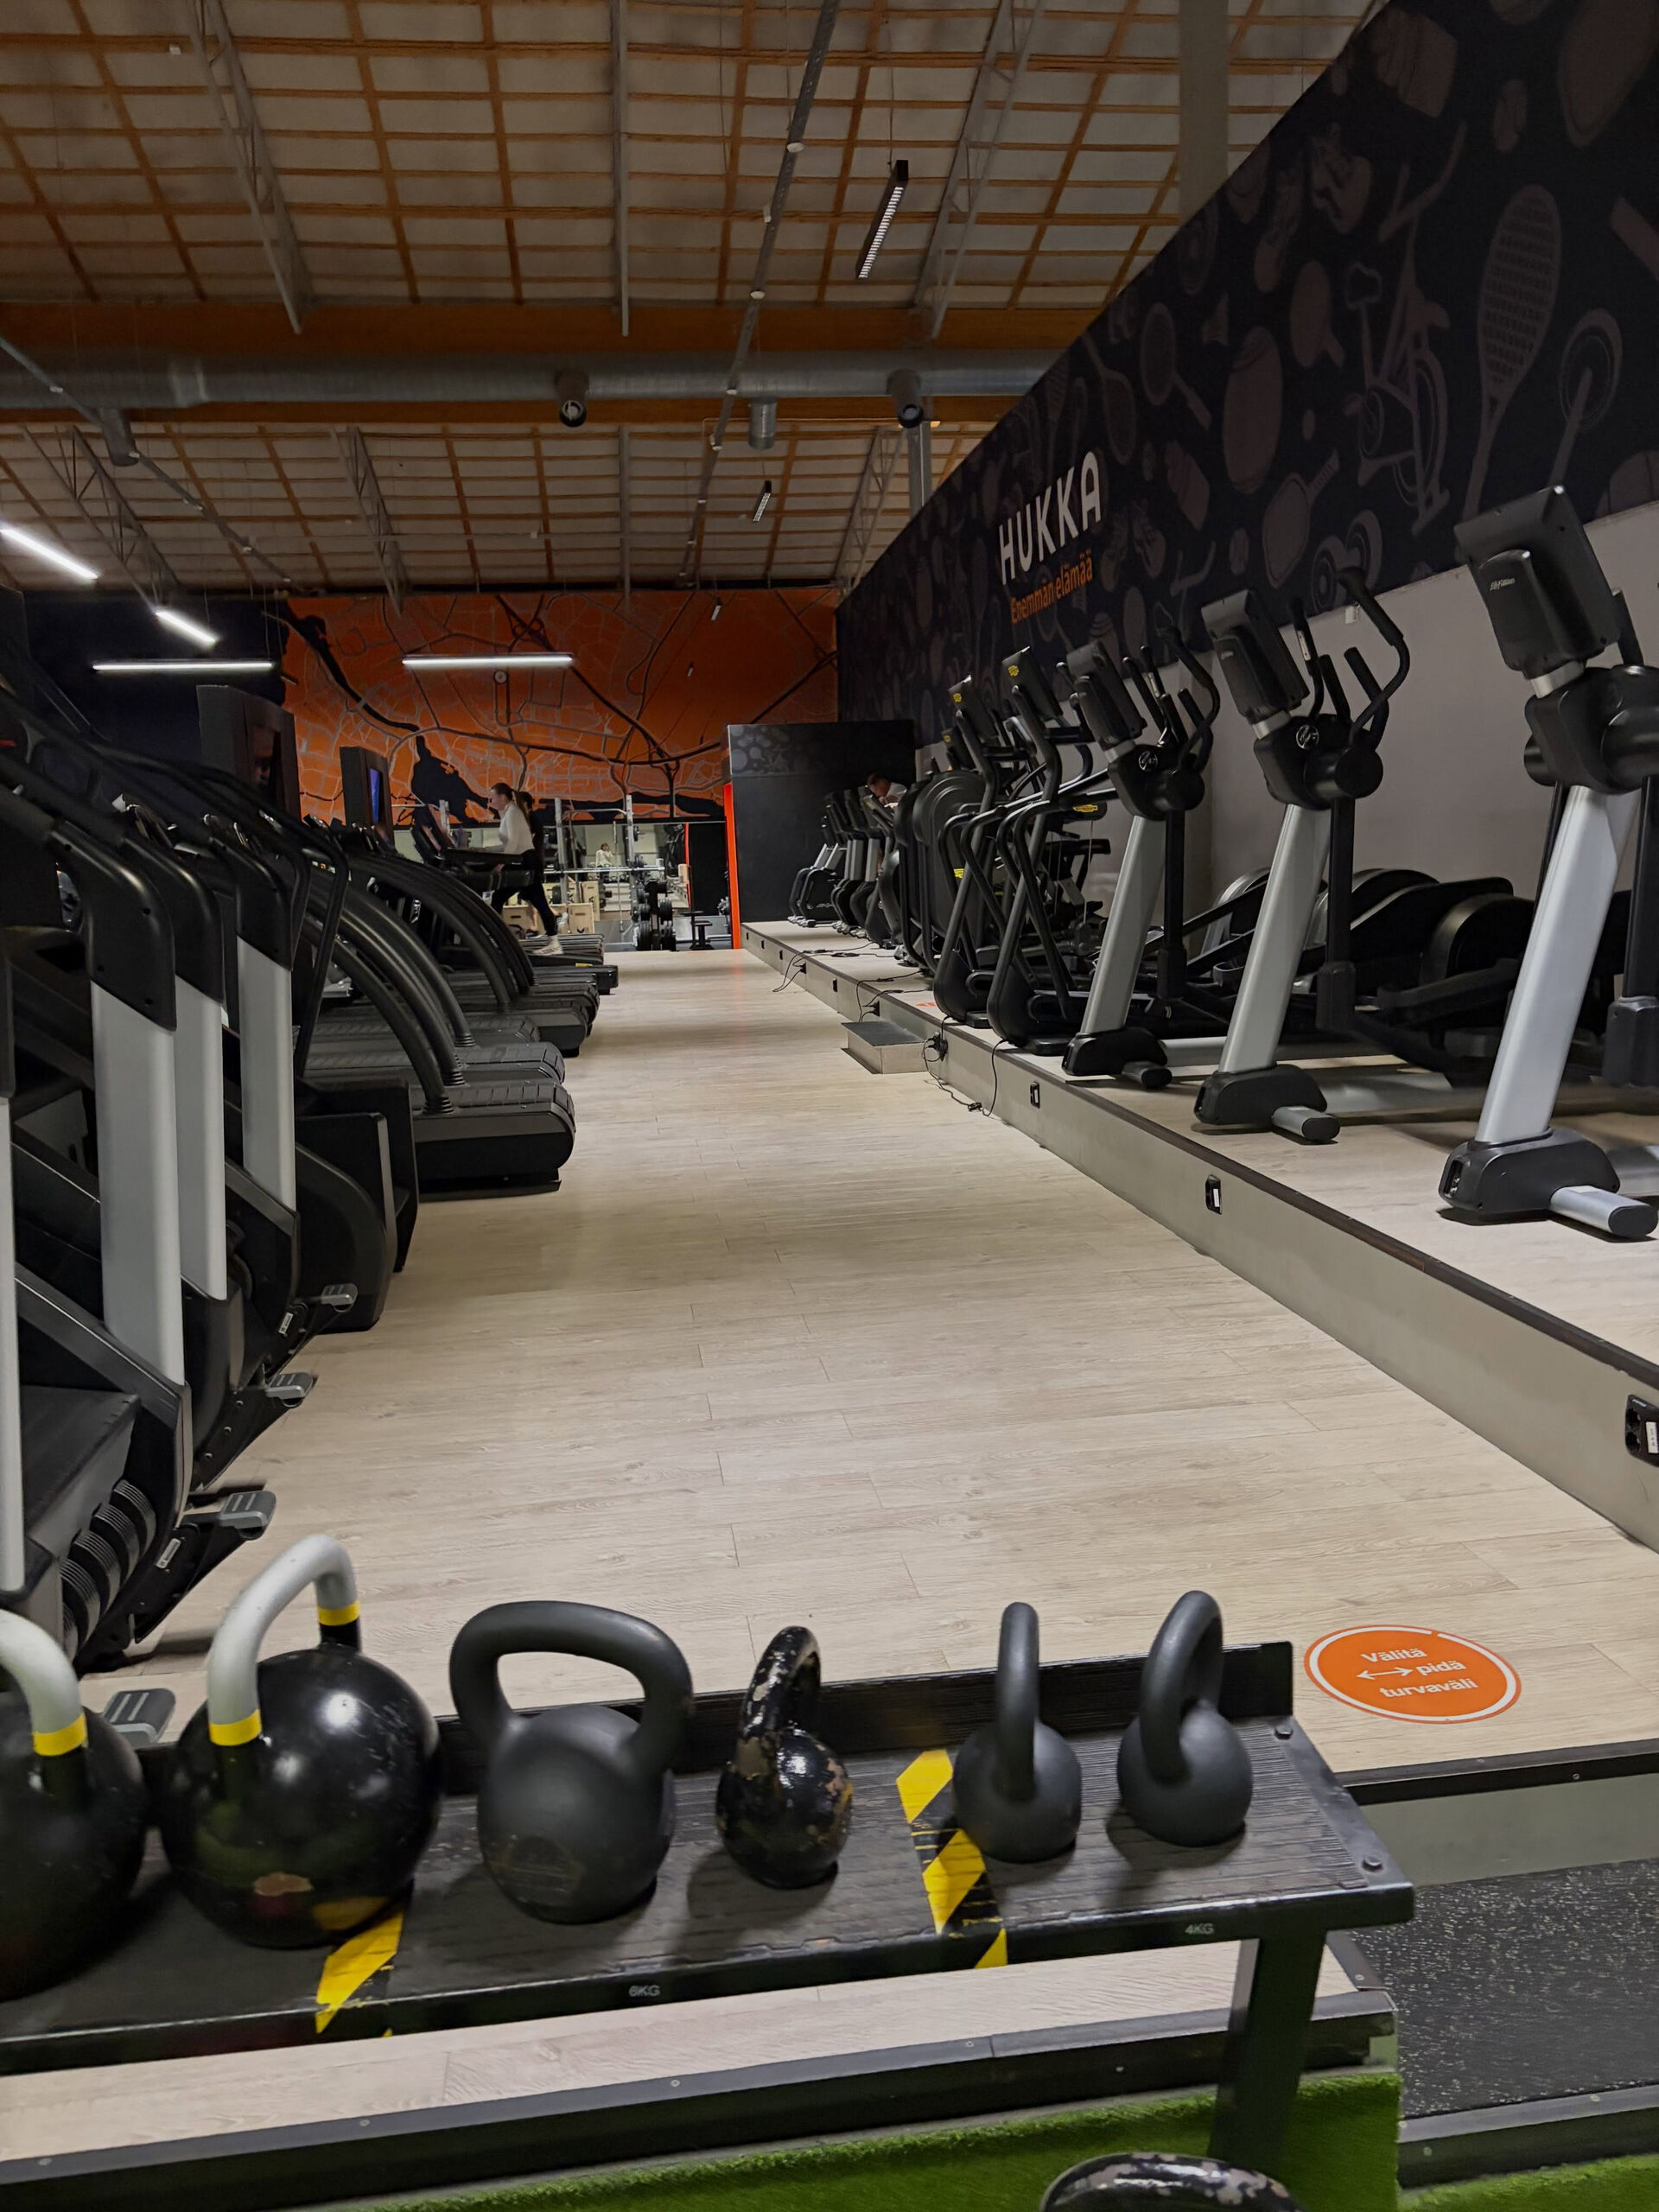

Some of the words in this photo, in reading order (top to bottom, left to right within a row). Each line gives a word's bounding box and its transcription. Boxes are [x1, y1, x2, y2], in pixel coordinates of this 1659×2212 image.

[999, 452, 1101, 585] HUKKA
[1056, 548, 1092, 600] elämää
[1361, 1648, 1427, 1662] Välitä
[1417, 1661, 1465, 1675] pidä
[1379, 1678, 1478, 1697] turvaväli
[1185, 1923, 1214, 1935] 4KG
[629, 1985, 660, 1997] 6KG
